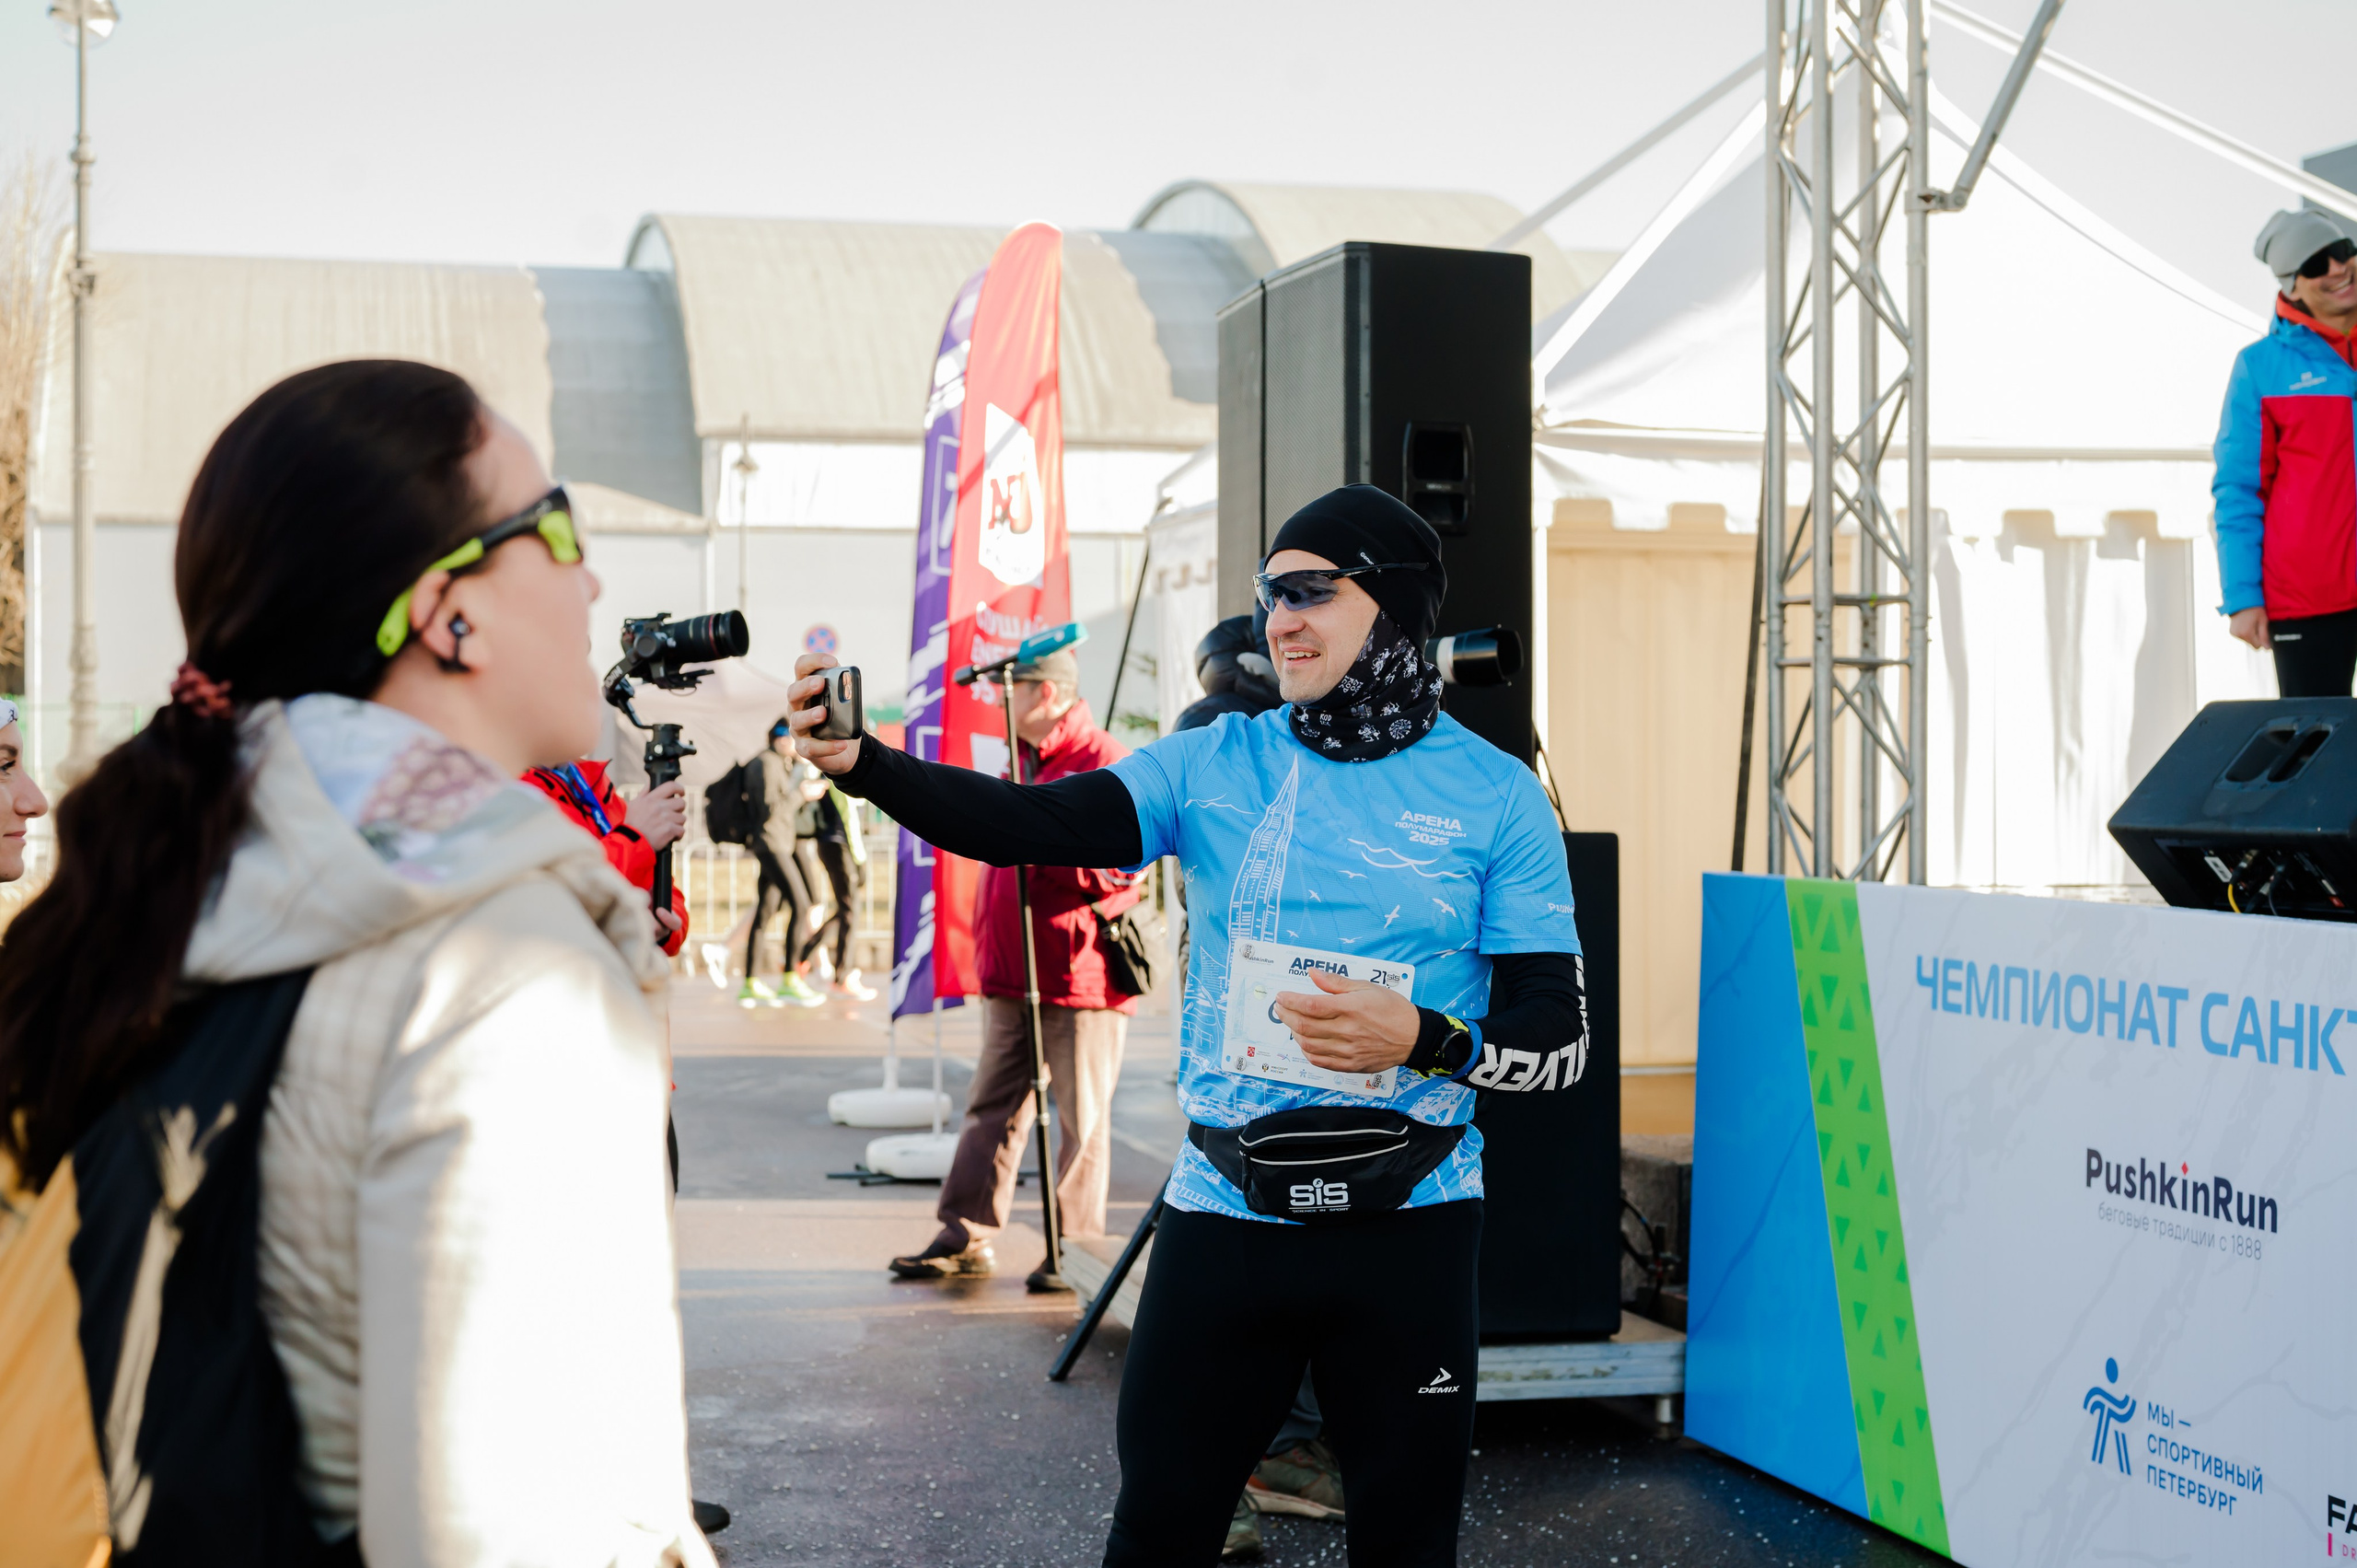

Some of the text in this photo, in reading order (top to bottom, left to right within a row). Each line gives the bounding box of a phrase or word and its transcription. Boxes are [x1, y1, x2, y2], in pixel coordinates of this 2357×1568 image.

[1395, 821, 1467, 838] ПОЛУМАРАФОН
[1401, 810, 1462, 831] АРЕНА
[1409, 830, 1450, 845] 2025
[1290, 957, 1349, 977] АРЕНА
[1917, 955, 2189, 1048] ЧЕМПИОНАТ
[1290, 1178, 1349, 1206] SiS
[2086, 1147, 2278, 1234] PushkinRun
[2098, 1202, 2149, 1231] беговые
[2153, 1218, 2215, 1248] традиции
[2231, 1235, 2262, 1260] 1888
[1418, 1385, 1460, 1393] DEMIX
[2148, 1401, 2174, 1429] МЫ
[2147, 1434, 2262, 1494] СПОРТИВНЫЙ
[2148, 1464, 2237, 1516] ПЕТЕРБУРГ
